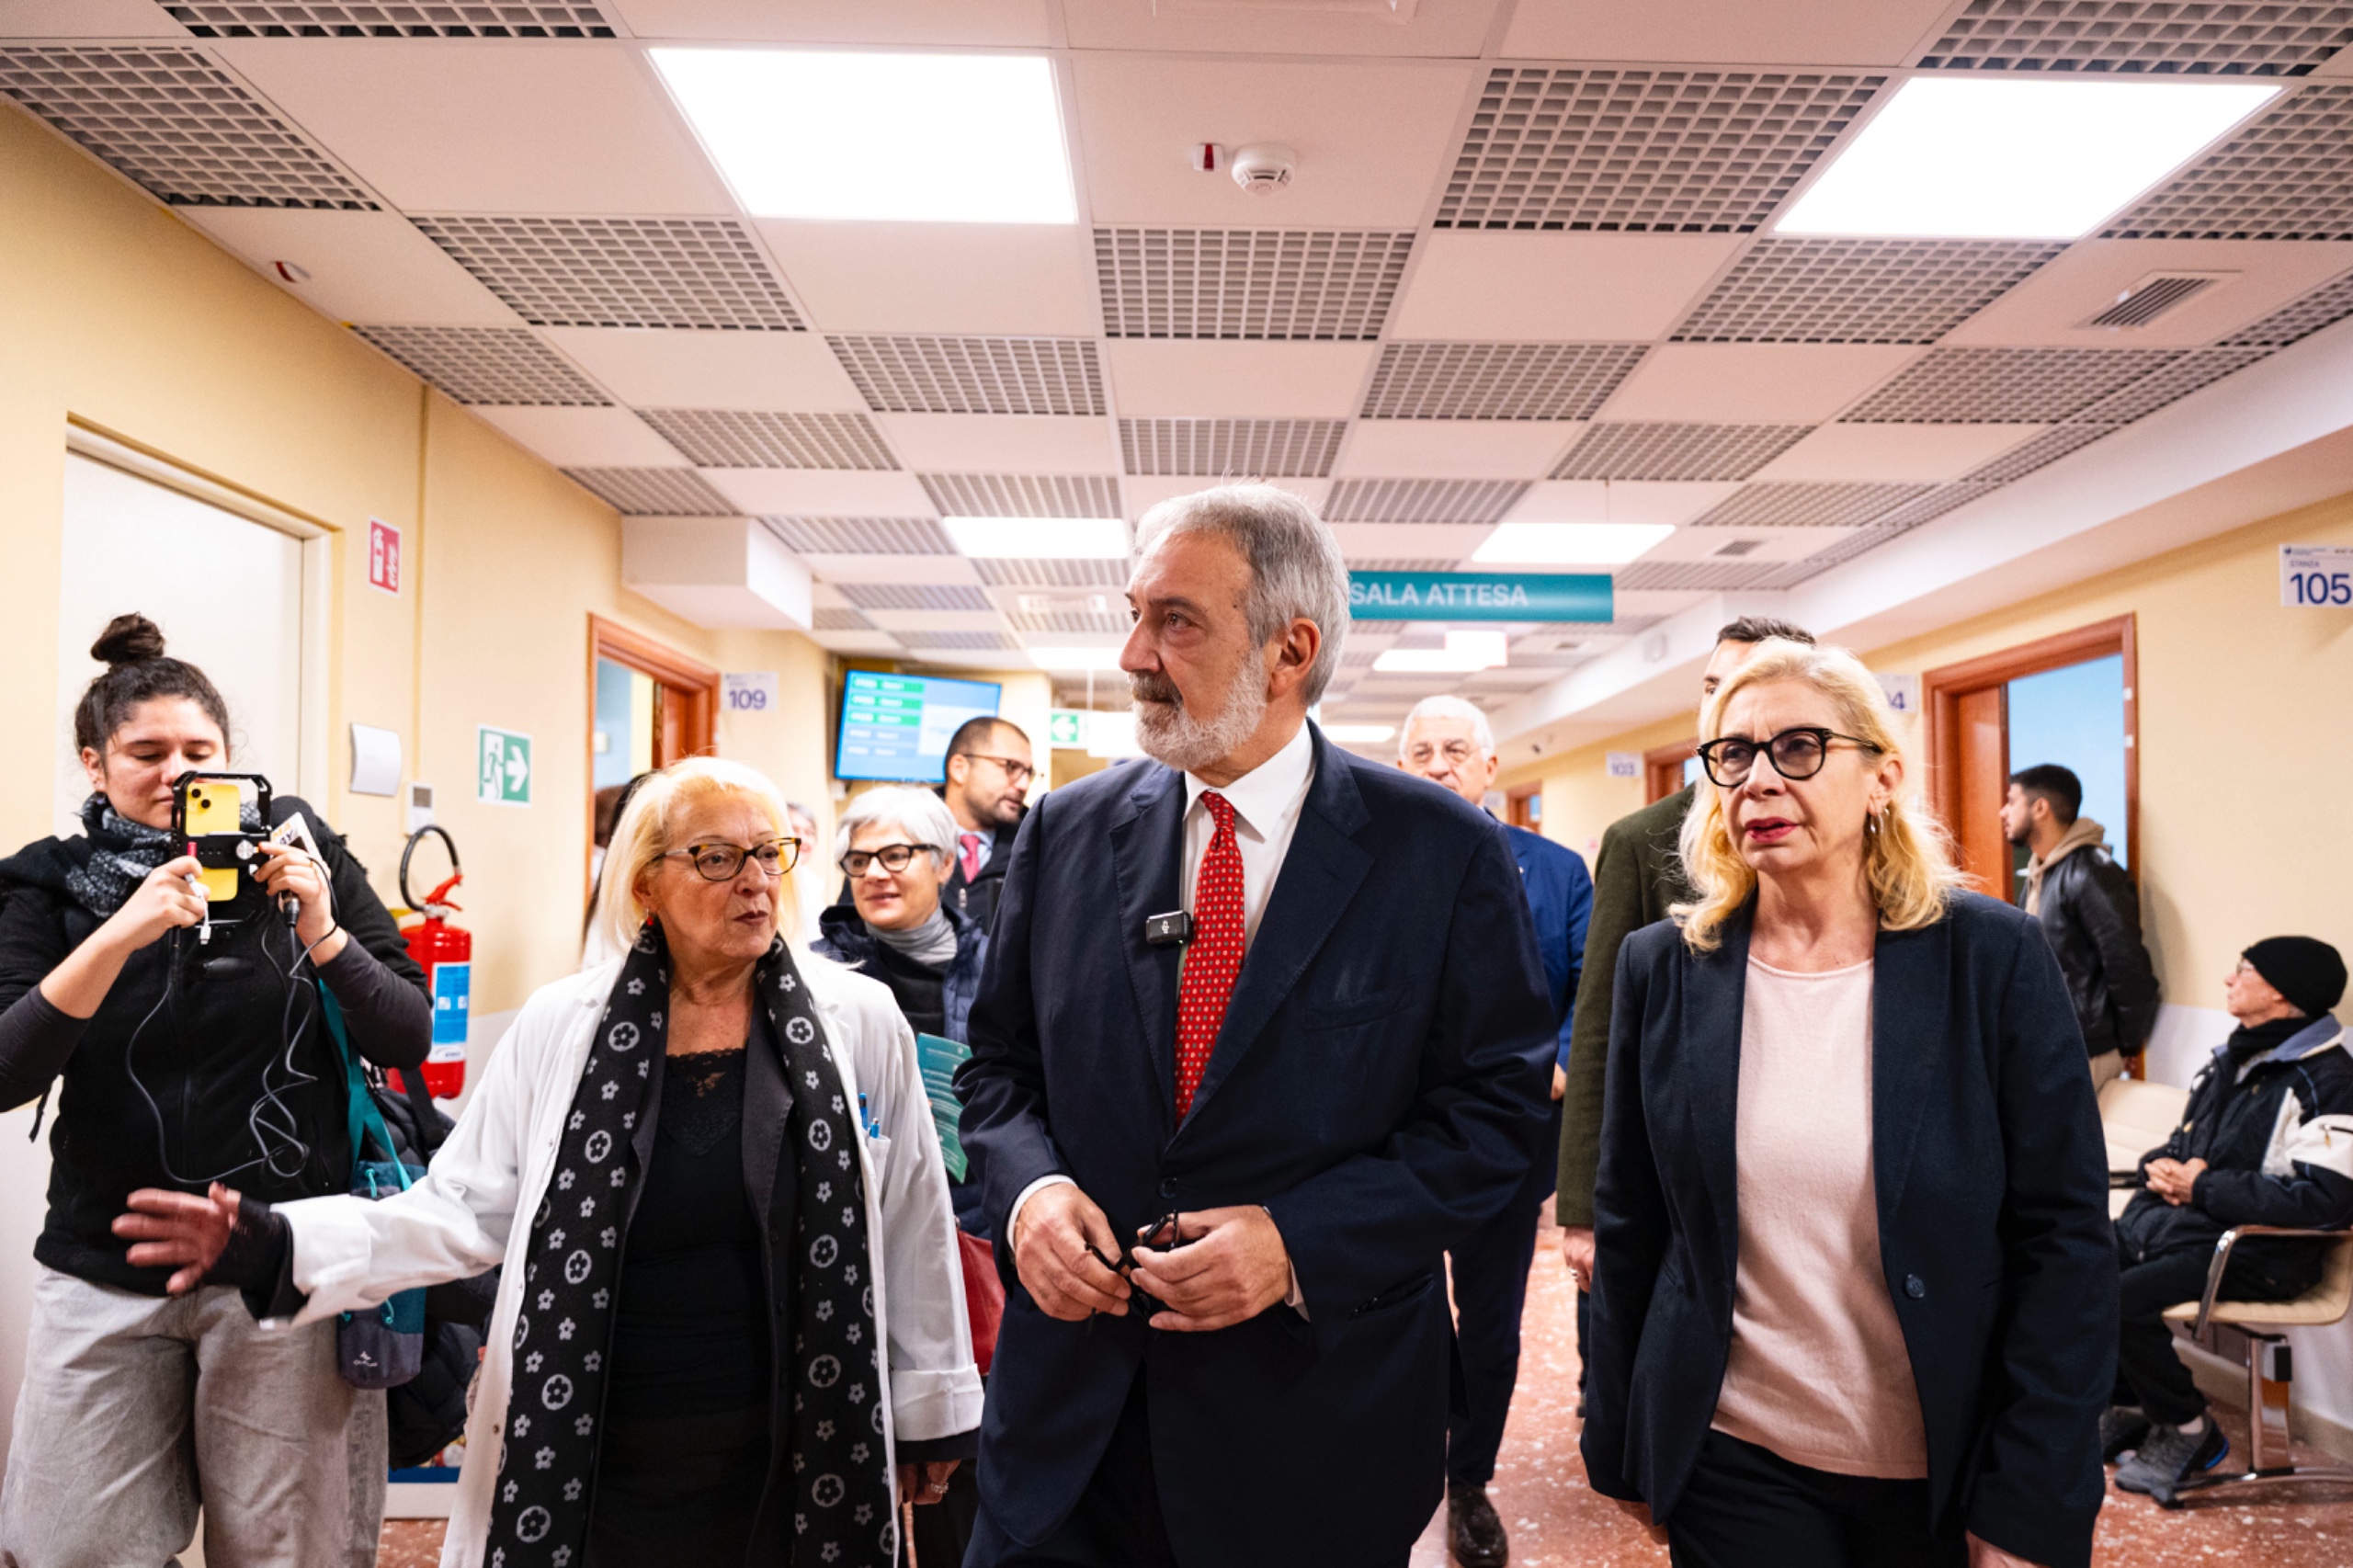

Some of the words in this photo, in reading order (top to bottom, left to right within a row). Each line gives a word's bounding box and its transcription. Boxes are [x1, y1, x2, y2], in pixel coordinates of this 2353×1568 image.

[1349, 583, 1420, 606] SALA
[1426, 583, 1529, 607] ATTESA
[2290, 573, 2352, 605] 105
[729, 688, 767, 710] 109
[1885, 690, 1905, 710] 4
